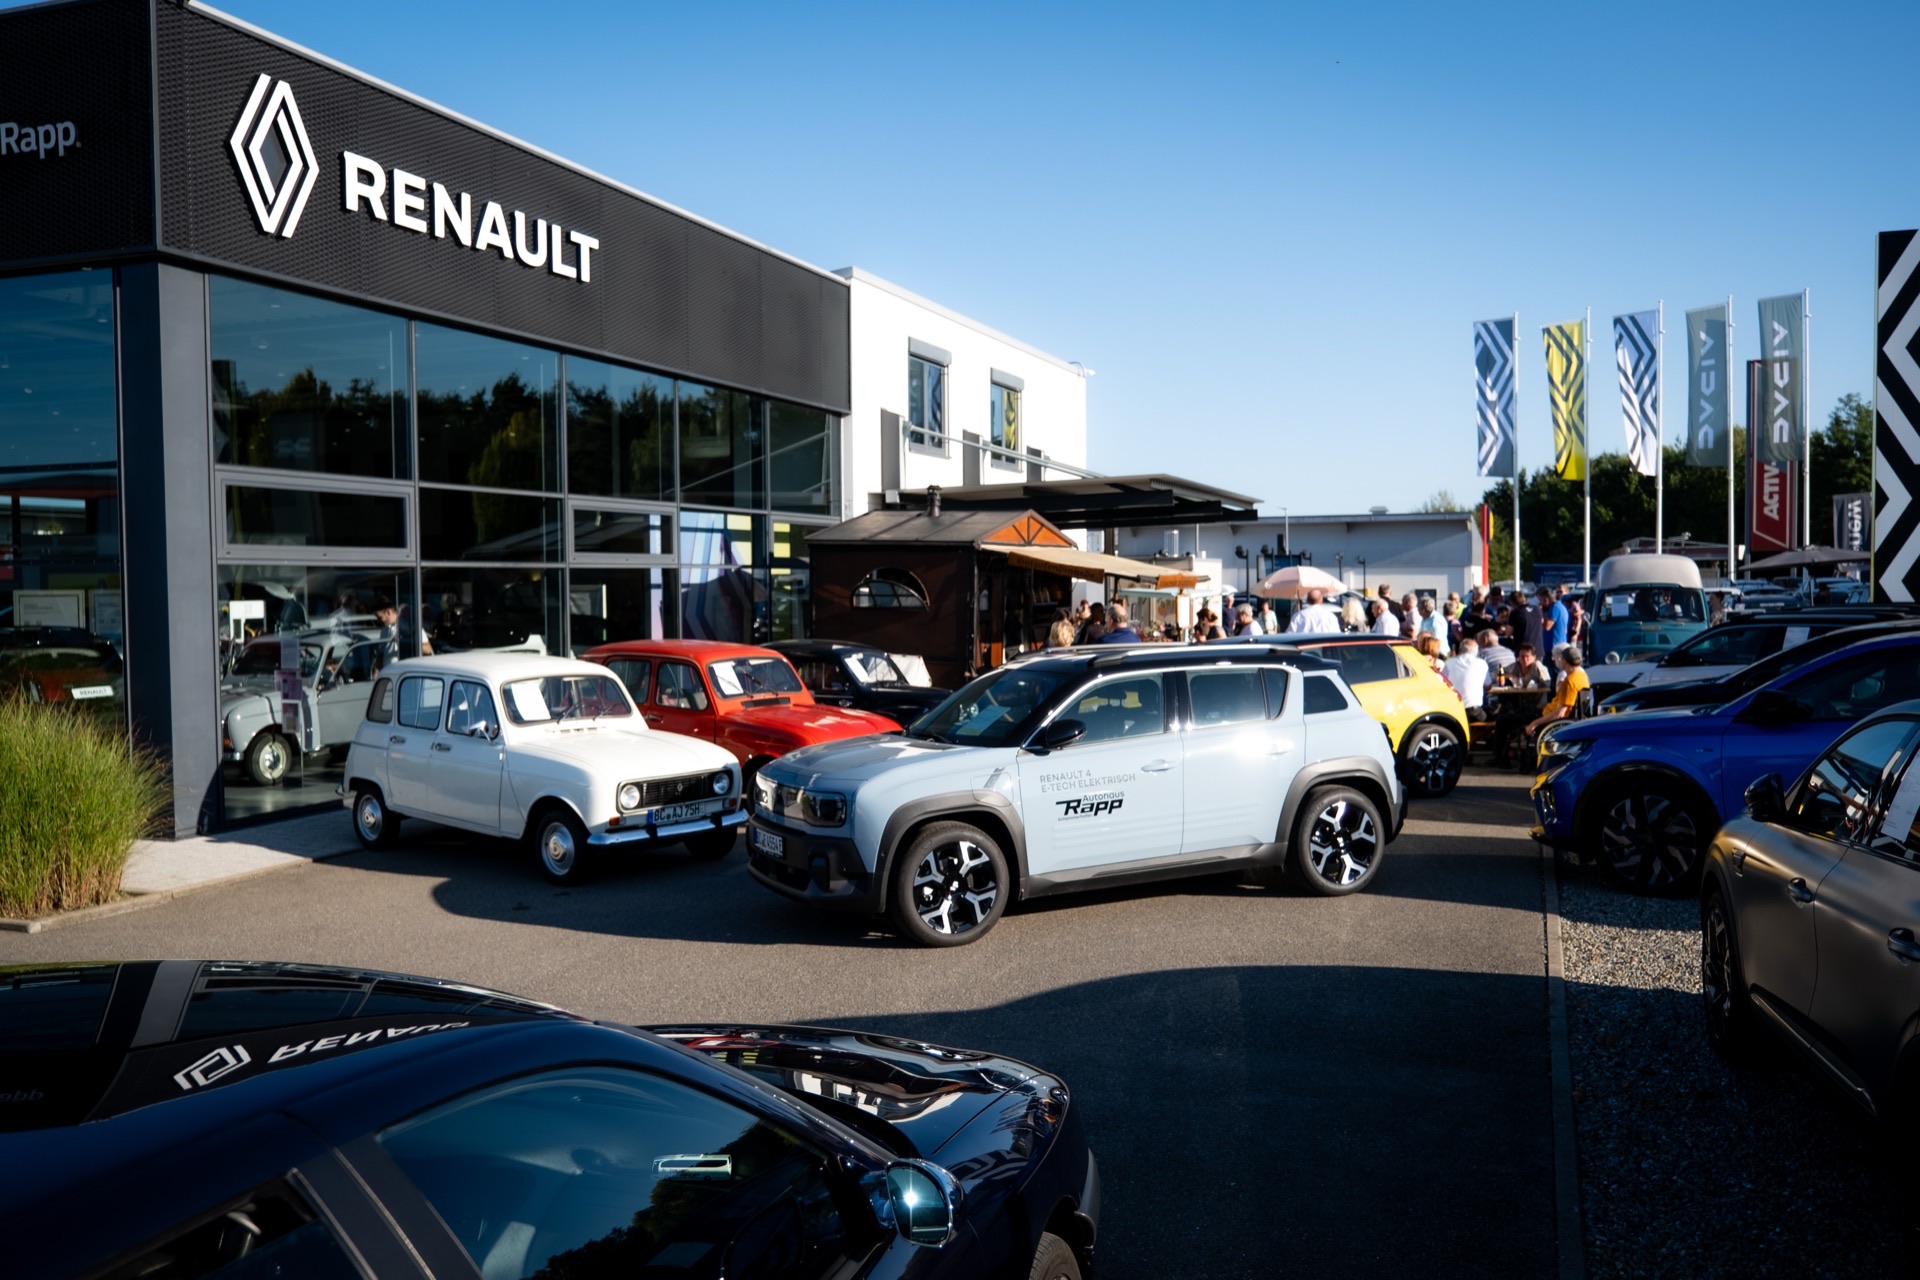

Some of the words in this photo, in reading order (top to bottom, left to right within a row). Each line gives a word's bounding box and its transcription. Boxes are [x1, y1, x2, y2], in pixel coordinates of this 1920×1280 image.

[343, 150, 600, 283] RENAULT
[1039, 770, 1083, 784] RENAULT
[1085, 769, 1092, 778] 4
[1041, 781, 1076, 793] E-TECH
[1078, 773, 1136, 788] ELEKTRISCH
[1055, 798, 1124, 816] Rapp
